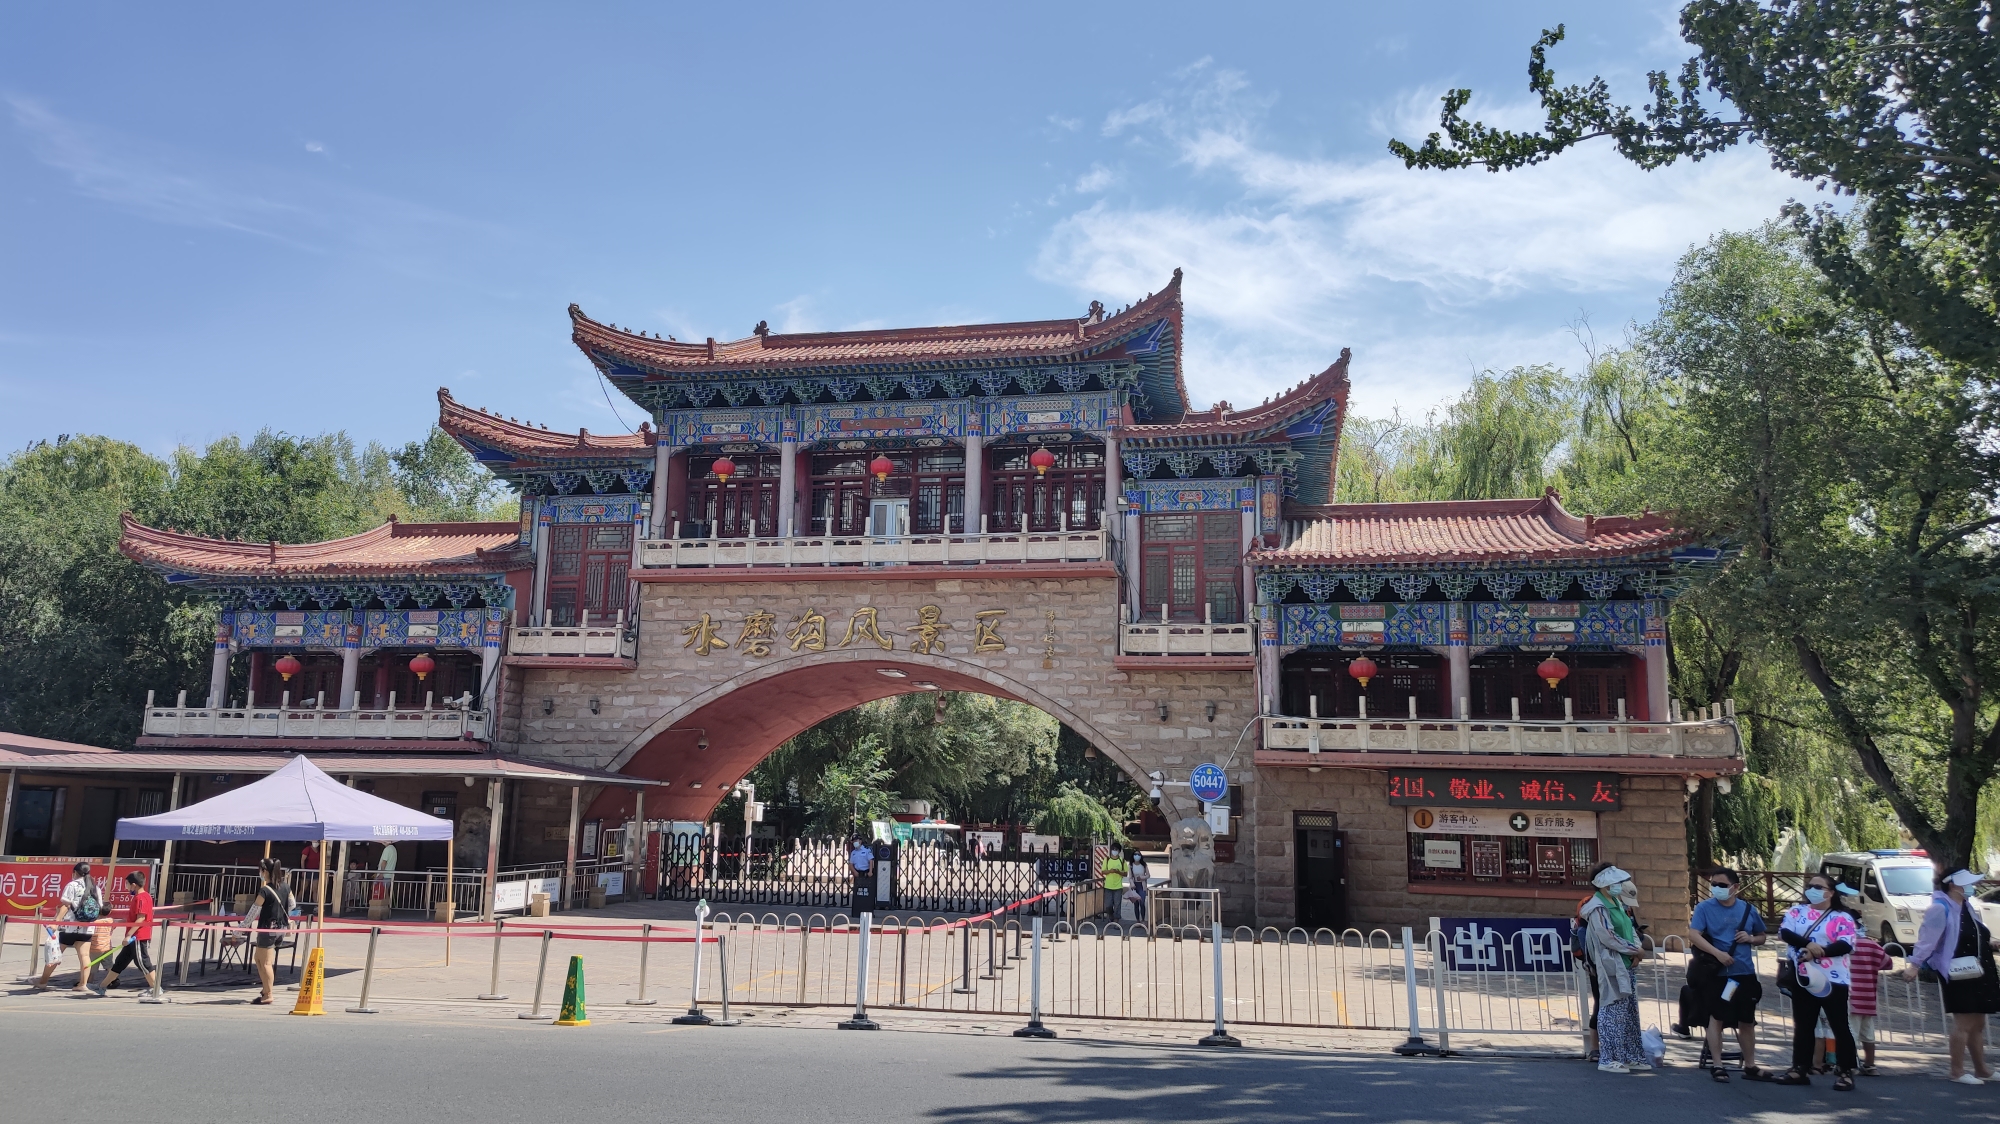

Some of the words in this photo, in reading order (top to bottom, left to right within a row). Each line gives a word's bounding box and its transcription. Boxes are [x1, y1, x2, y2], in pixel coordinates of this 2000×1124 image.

[682, 604, 1008, 657] 水磨沟风景区
[1194, 774, 1224, 789] 50447
[1439, 813, 1479, 825] 游客中心
[1535, 817, 1576, 828] 医疗服务
[1455, 922, 1561, 967] 出口
